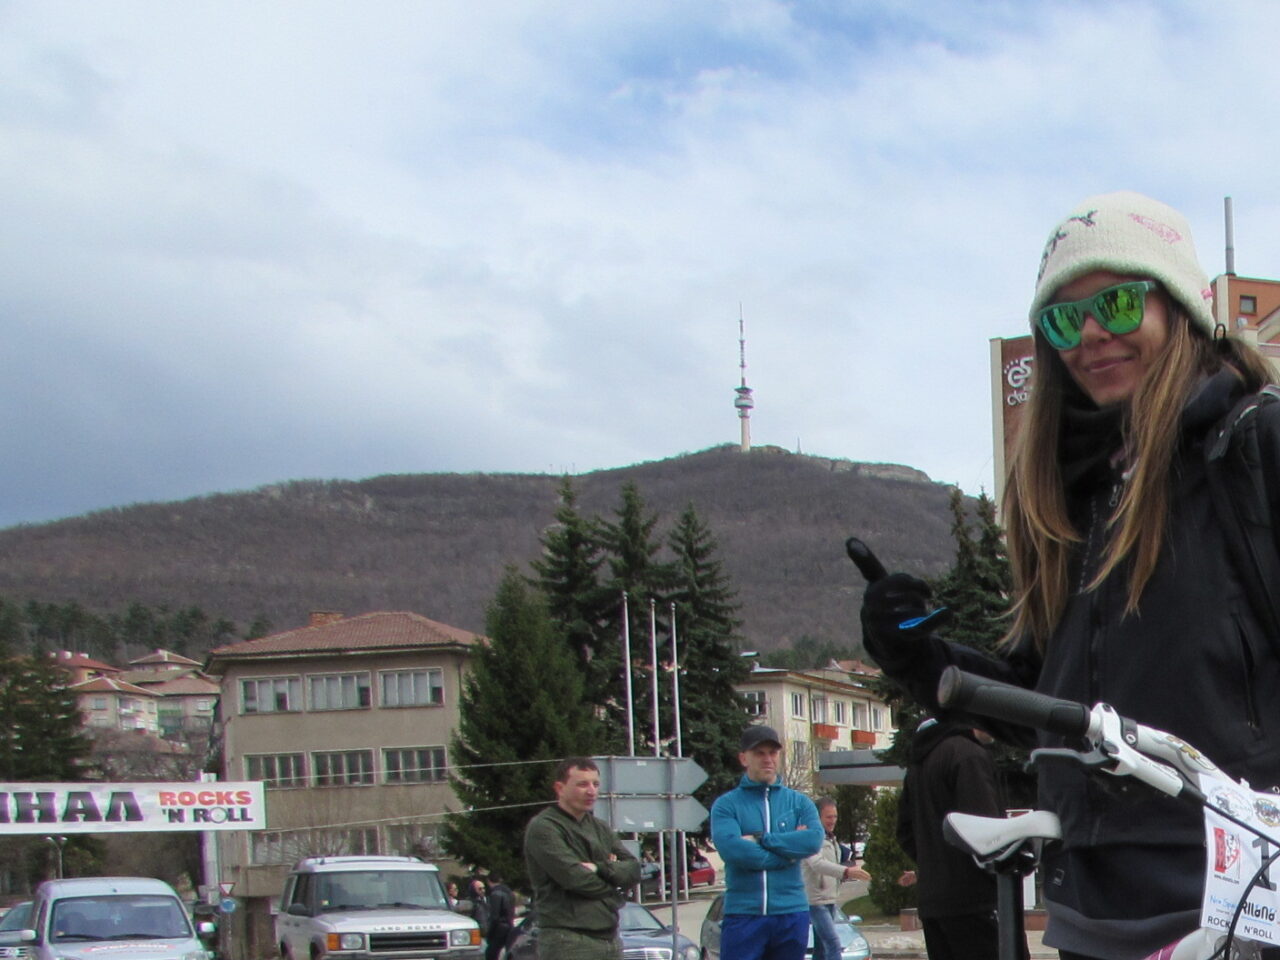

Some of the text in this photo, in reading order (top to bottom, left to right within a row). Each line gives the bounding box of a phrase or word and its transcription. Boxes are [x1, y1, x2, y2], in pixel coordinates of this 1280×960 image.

[158, 790, 253, 806] ROCKS
[0, 791, 144, 823] НАЛ
[193, 807, 254, 824] ROLL
